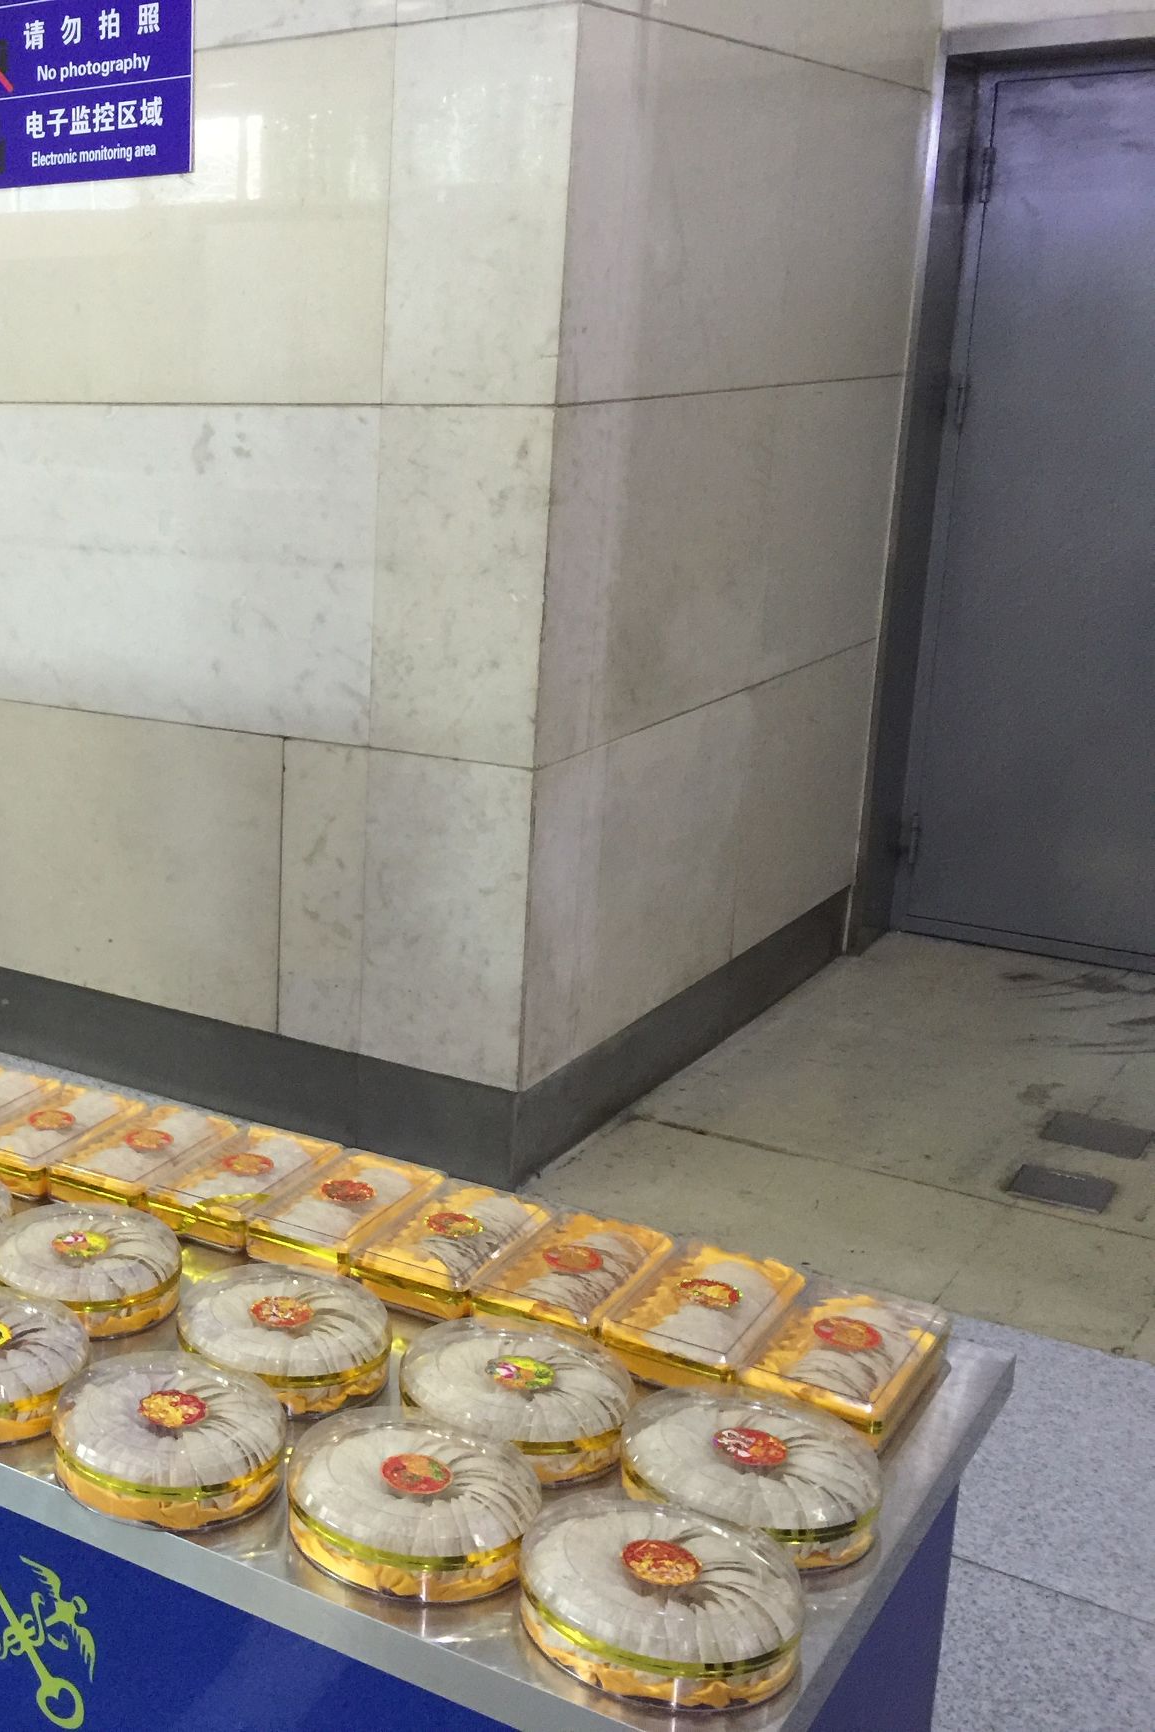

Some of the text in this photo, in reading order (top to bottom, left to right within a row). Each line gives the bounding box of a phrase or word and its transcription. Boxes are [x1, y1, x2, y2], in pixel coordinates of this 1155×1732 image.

[24, 2, 160, 50] 请勿拍照
[37, 53, 151, 82] No photography
[26, 96, 163, 139] 电子监控区域
[32, 143, 156, 167] Electronic monitoring area
